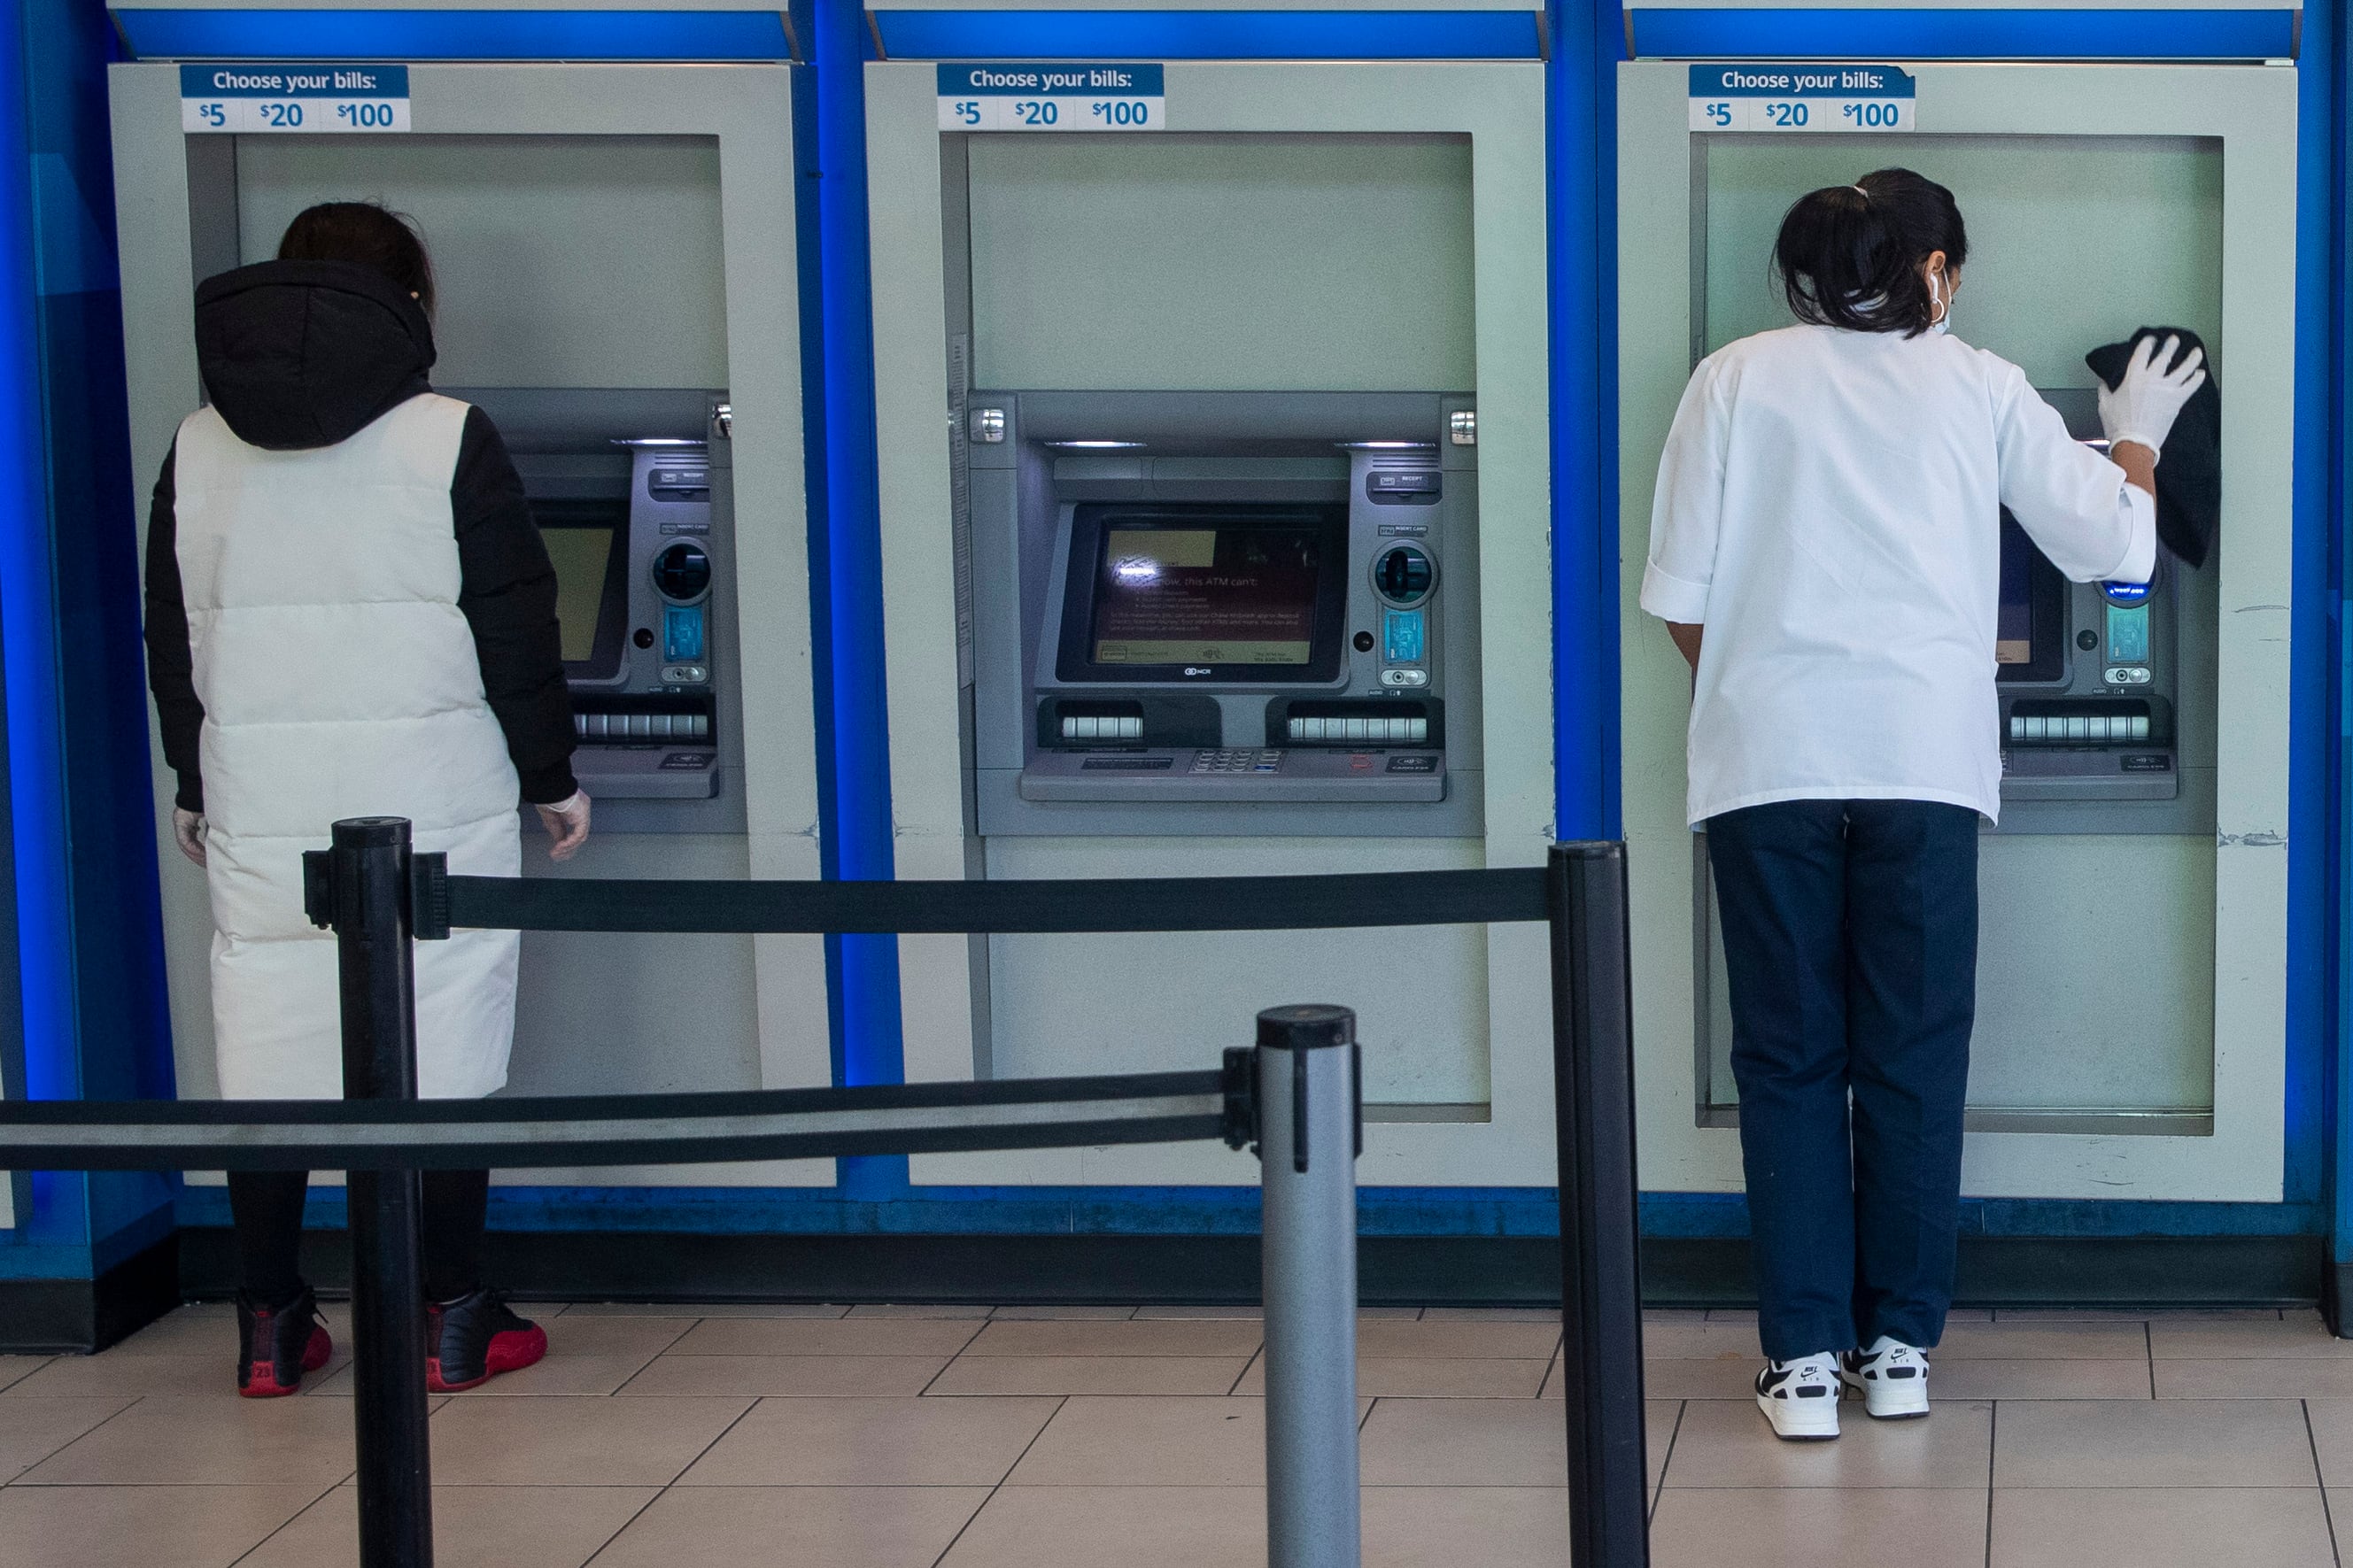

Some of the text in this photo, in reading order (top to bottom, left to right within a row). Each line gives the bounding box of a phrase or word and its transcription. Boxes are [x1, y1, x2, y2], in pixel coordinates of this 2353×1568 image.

[213, 72, 376, 93] Choose your bills:
[970, 70, 1132, 91] Choose your bills:
[1722, 71, 1884, 93] Choose your bills:
[199, 104, 393, 127] $5 $20 $100
[956, 102, 1148, 125] $5 $20 $100
[1707, 103, 1899, 126] $5 $20 $100
[1205, 576, 1229, 586] ATM
